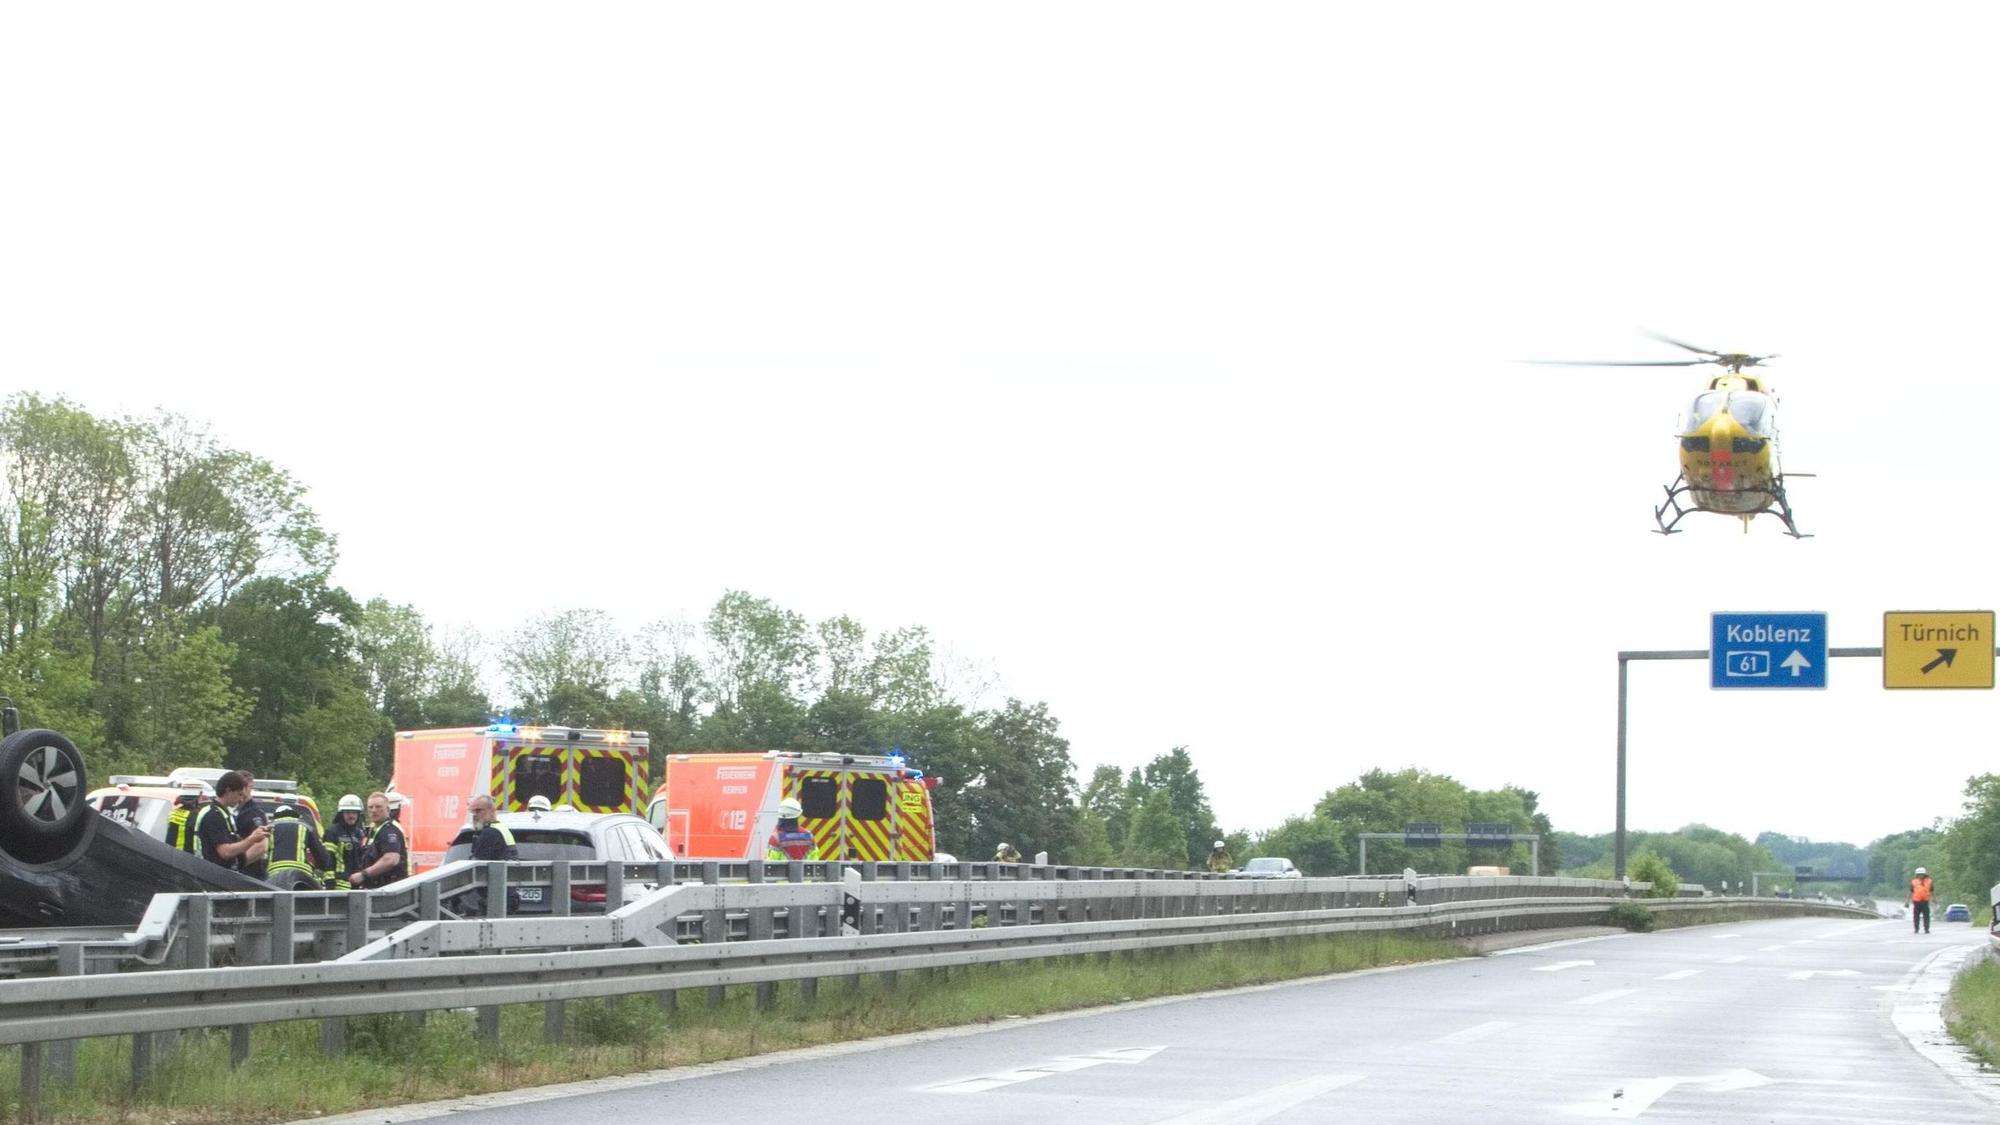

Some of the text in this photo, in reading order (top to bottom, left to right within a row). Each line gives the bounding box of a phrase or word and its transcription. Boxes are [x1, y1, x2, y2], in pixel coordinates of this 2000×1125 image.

[1727, 624, 1811, 642] Koblenz
[1900, 623, 1979, 641] Türnich
[1740, 656, 1757, 672] 61
